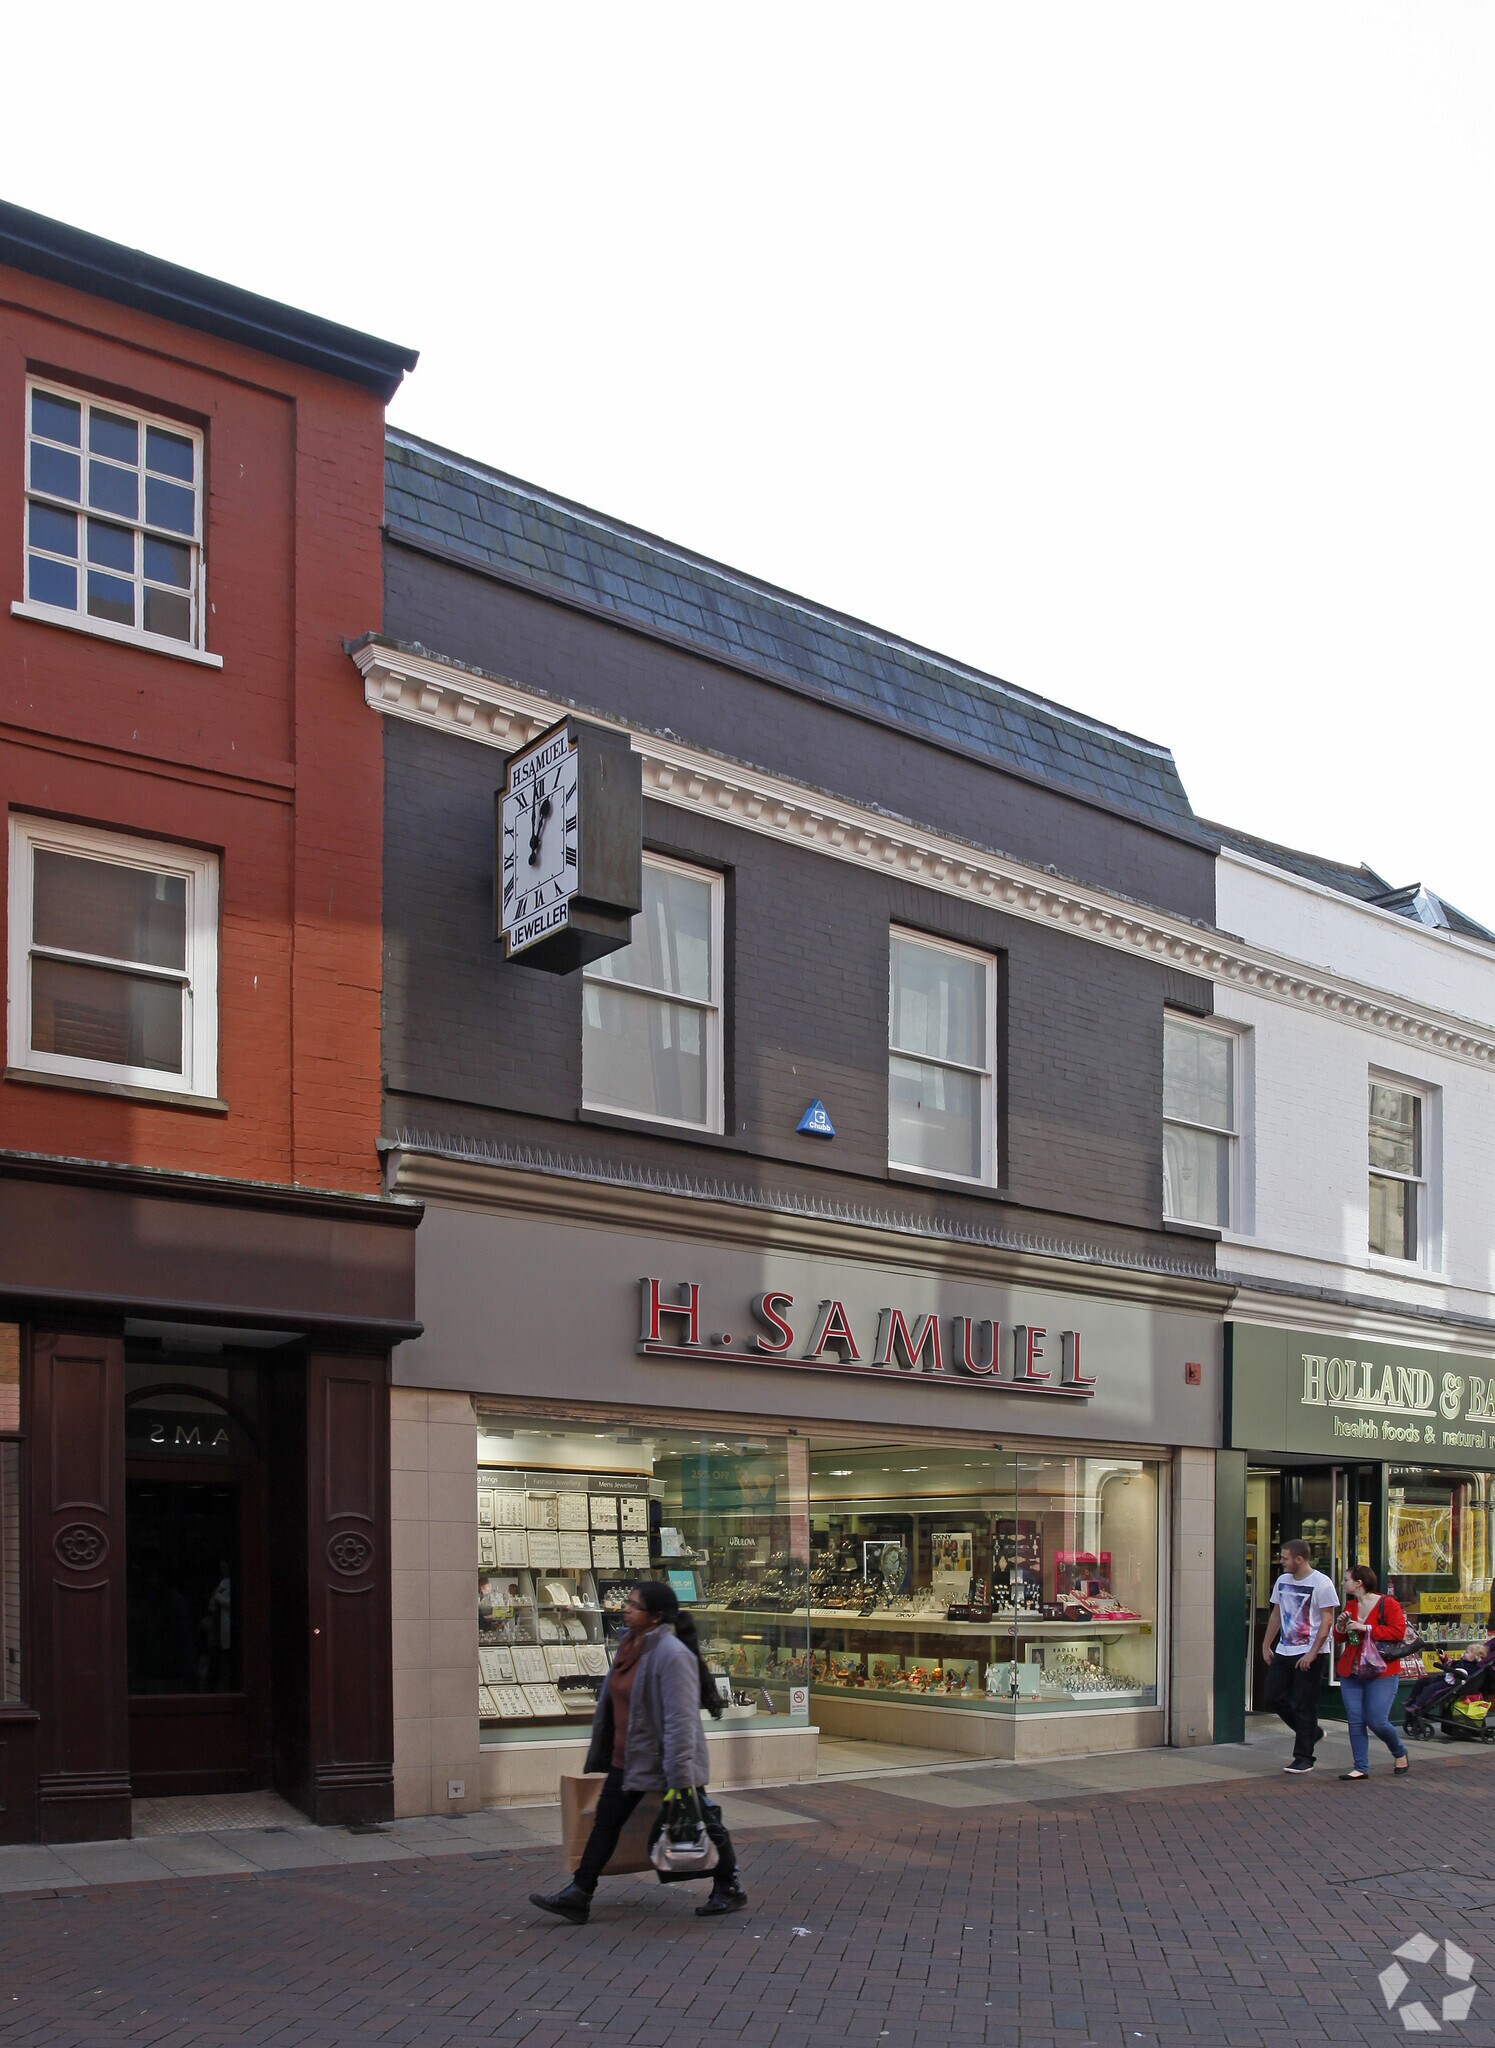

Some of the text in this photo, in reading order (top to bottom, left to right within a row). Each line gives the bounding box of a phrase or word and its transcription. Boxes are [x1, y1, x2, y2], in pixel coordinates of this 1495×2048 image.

[511, 903, 568, 947] JEWELLER
[809, 1121, 831, 1131] Chubb
[748, 1290, 1098, 1386] SAMUEL
[1301, 1354, 1435, 1409] HOLLAND
[1439, 1372, 1465, 1420] &
[1333, 1416, 1379, 1439] health
[1382, 1420, 1420, 1443] foods
[1423, 1425, 1436, 1445] &
[1442, 1430, 1486, 1449] natural
[482, 1475, 499, 1484] Rings
[690, 1469, 730, 1480] 25% OFF
[556, 1479, 581, 1487] Jewellery
[614, 1481, 639, 1489] Jewellery
